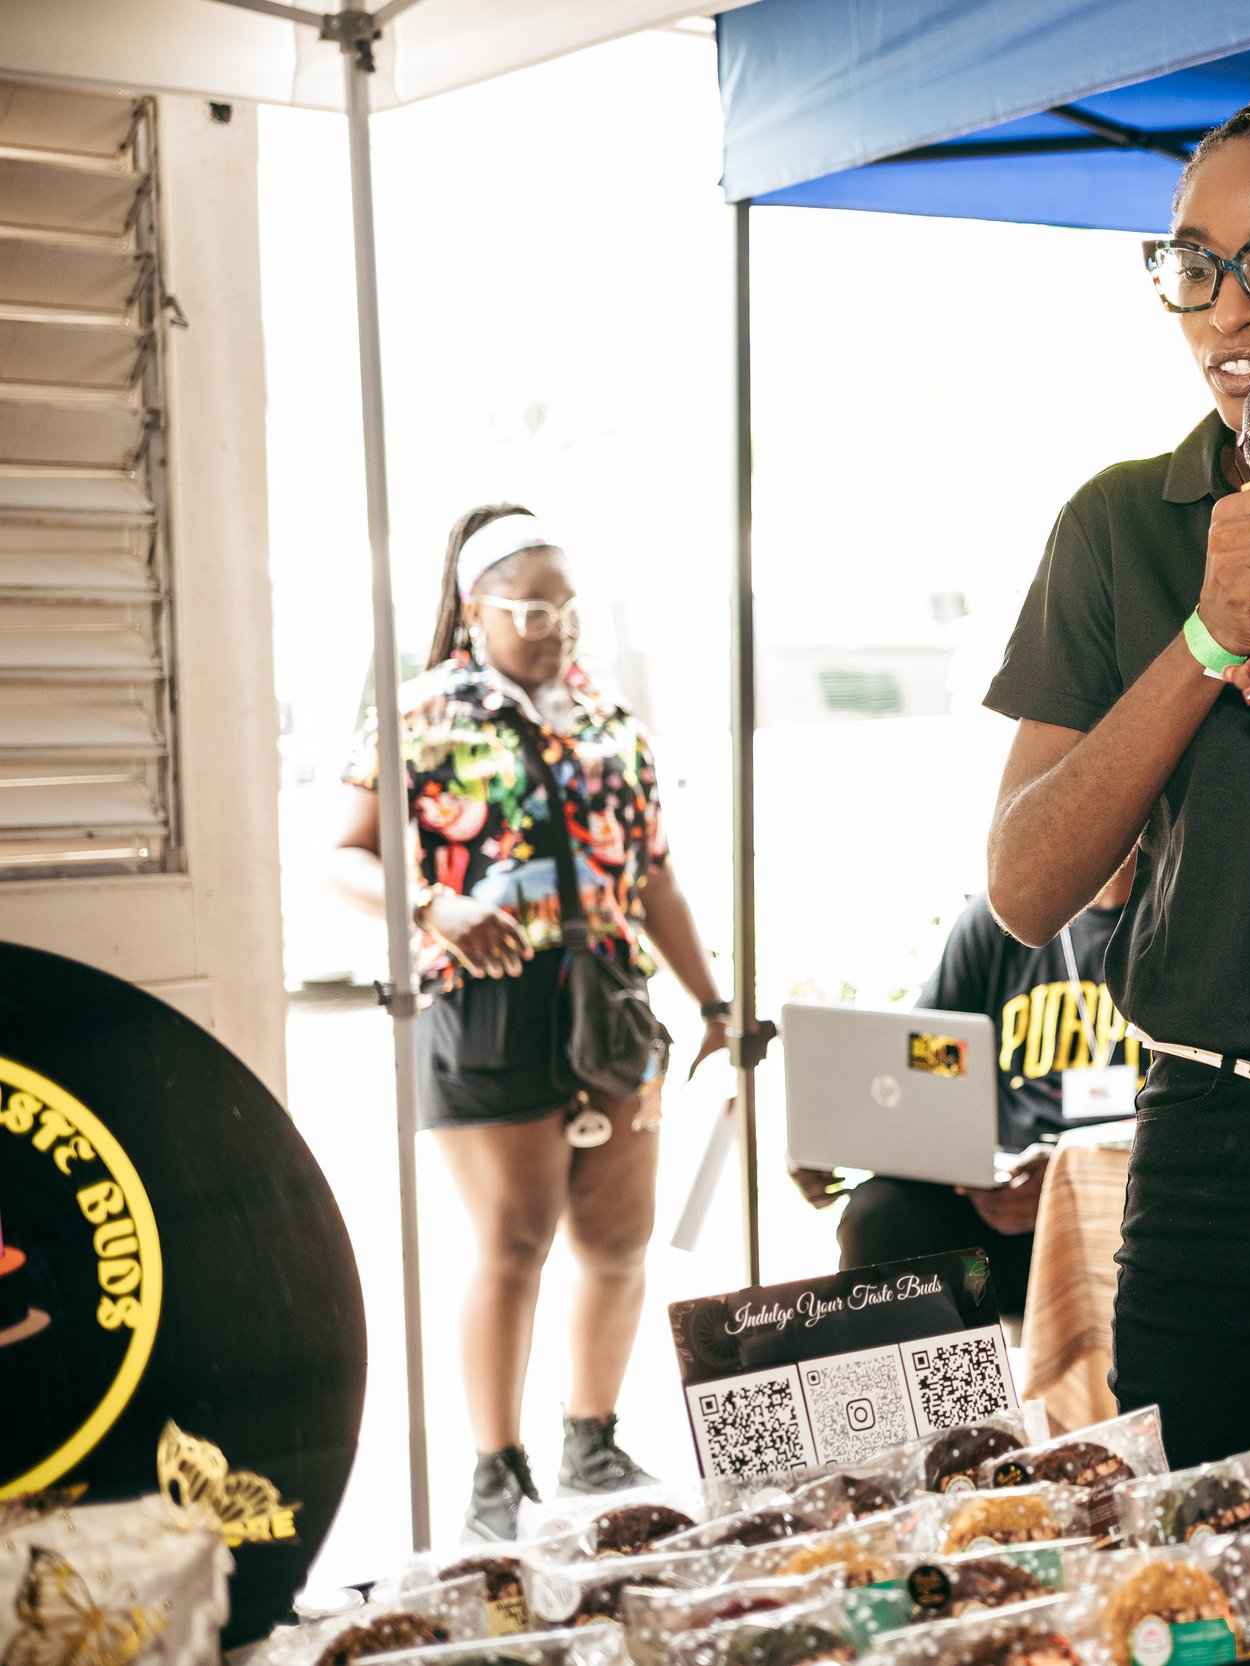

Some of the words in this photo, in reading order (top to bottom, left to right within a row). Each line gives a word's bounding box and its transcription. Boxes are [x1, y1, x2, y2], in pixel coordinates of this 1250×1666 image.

[77, 1181, 143, 1330] BUDS
[724, 1302, 795, 1335] Indulge
[796, 1291, 844, 1328] Your
[847, 1284, 894, 1311] Taste
[896, 1274, 943, 1301] Buds
